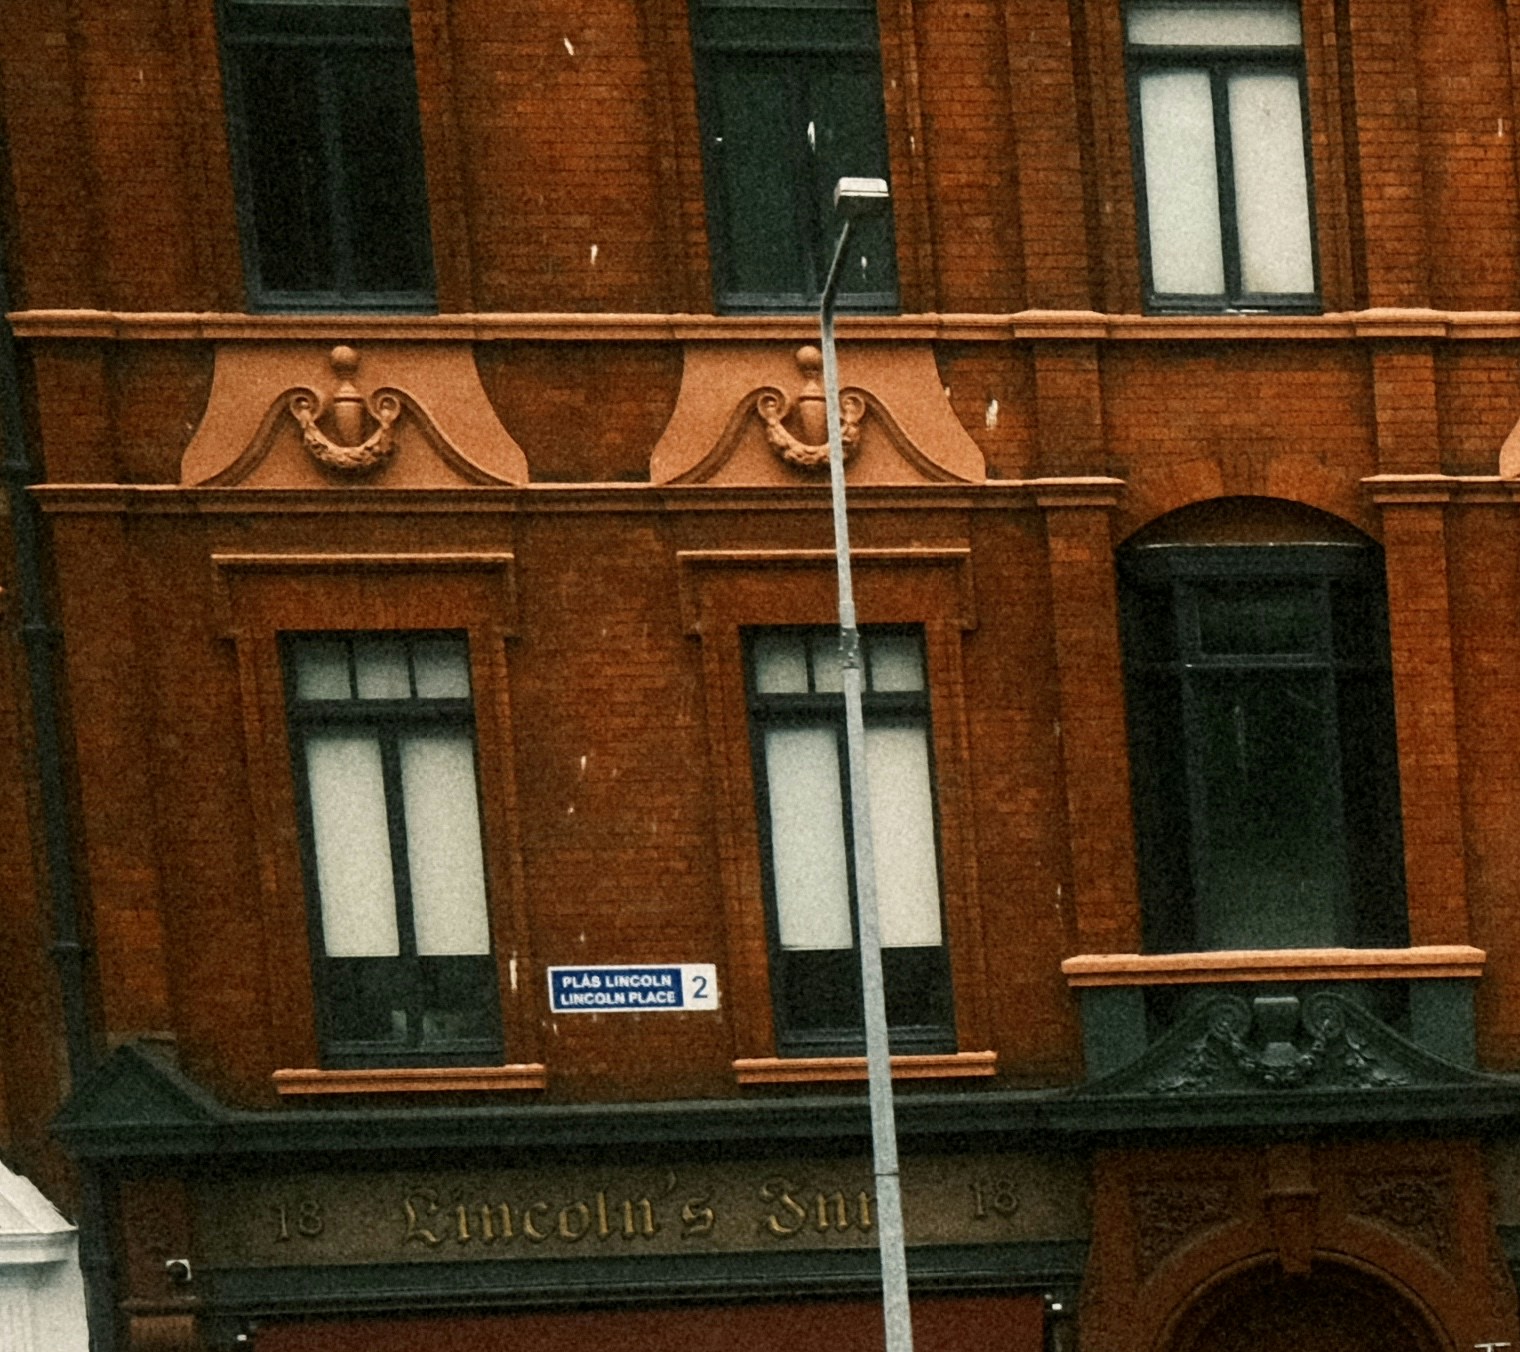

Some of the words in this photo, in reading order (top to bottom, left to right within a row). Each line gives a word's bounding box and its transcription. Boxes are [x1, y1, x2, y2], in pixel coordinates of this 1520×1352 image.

[560, 992, 626, 1006] LINCOLN
[628, 991, 676, 1004] PLACE
[562, 973, 601, 988] PLÁS
[605, 974, 672, 987] LINCOLN
[691, 975, 708, 999] 2
[271, 1200, 324, 1244] 18
[400, 1170, 715, 1248] Lincoln's
[969, 1178, 1020, 1219] 18
